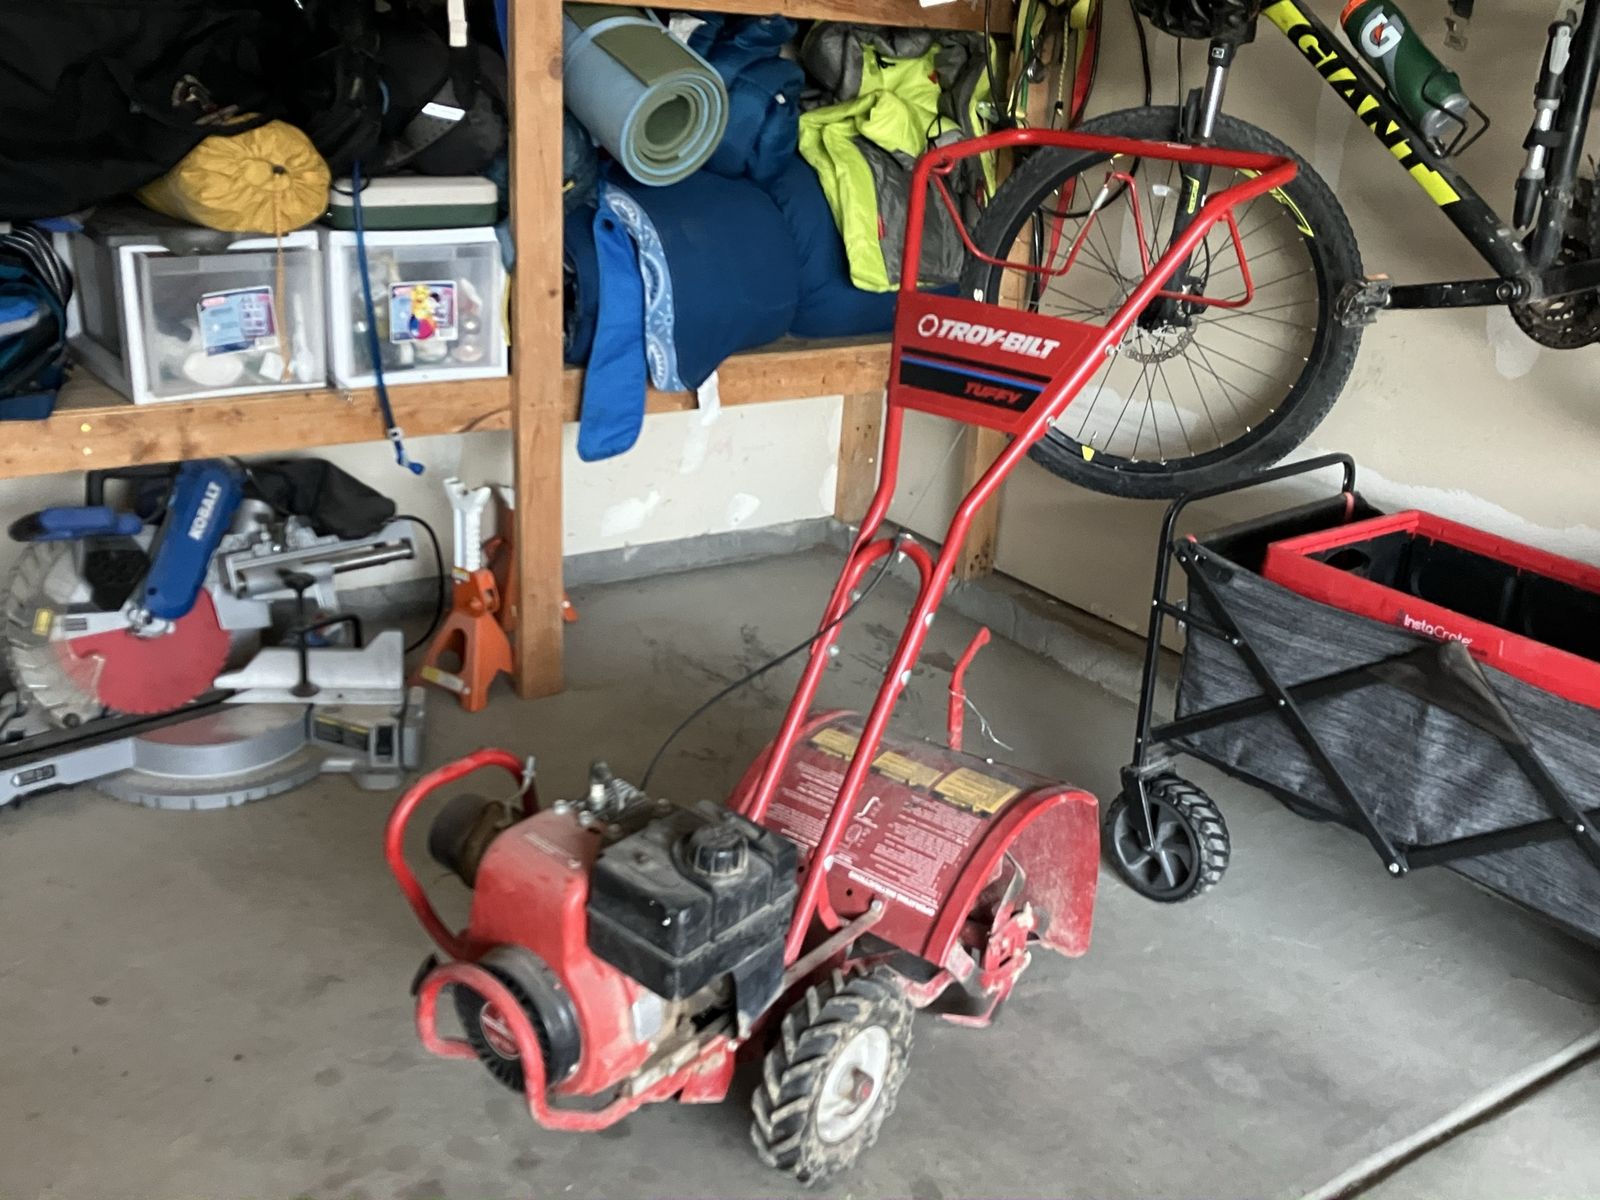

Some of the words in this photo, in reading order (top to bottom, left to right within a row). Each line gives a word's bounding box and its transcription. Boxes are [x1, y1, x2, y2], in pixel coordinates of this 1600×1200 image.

[1287, 22, 1434, 173] GIANT
[937, 319, 1060, 360] TROY-BILT
[963, 381, 1024, 405] TUFFY
[187, 481, 222, 541] KOBALT
